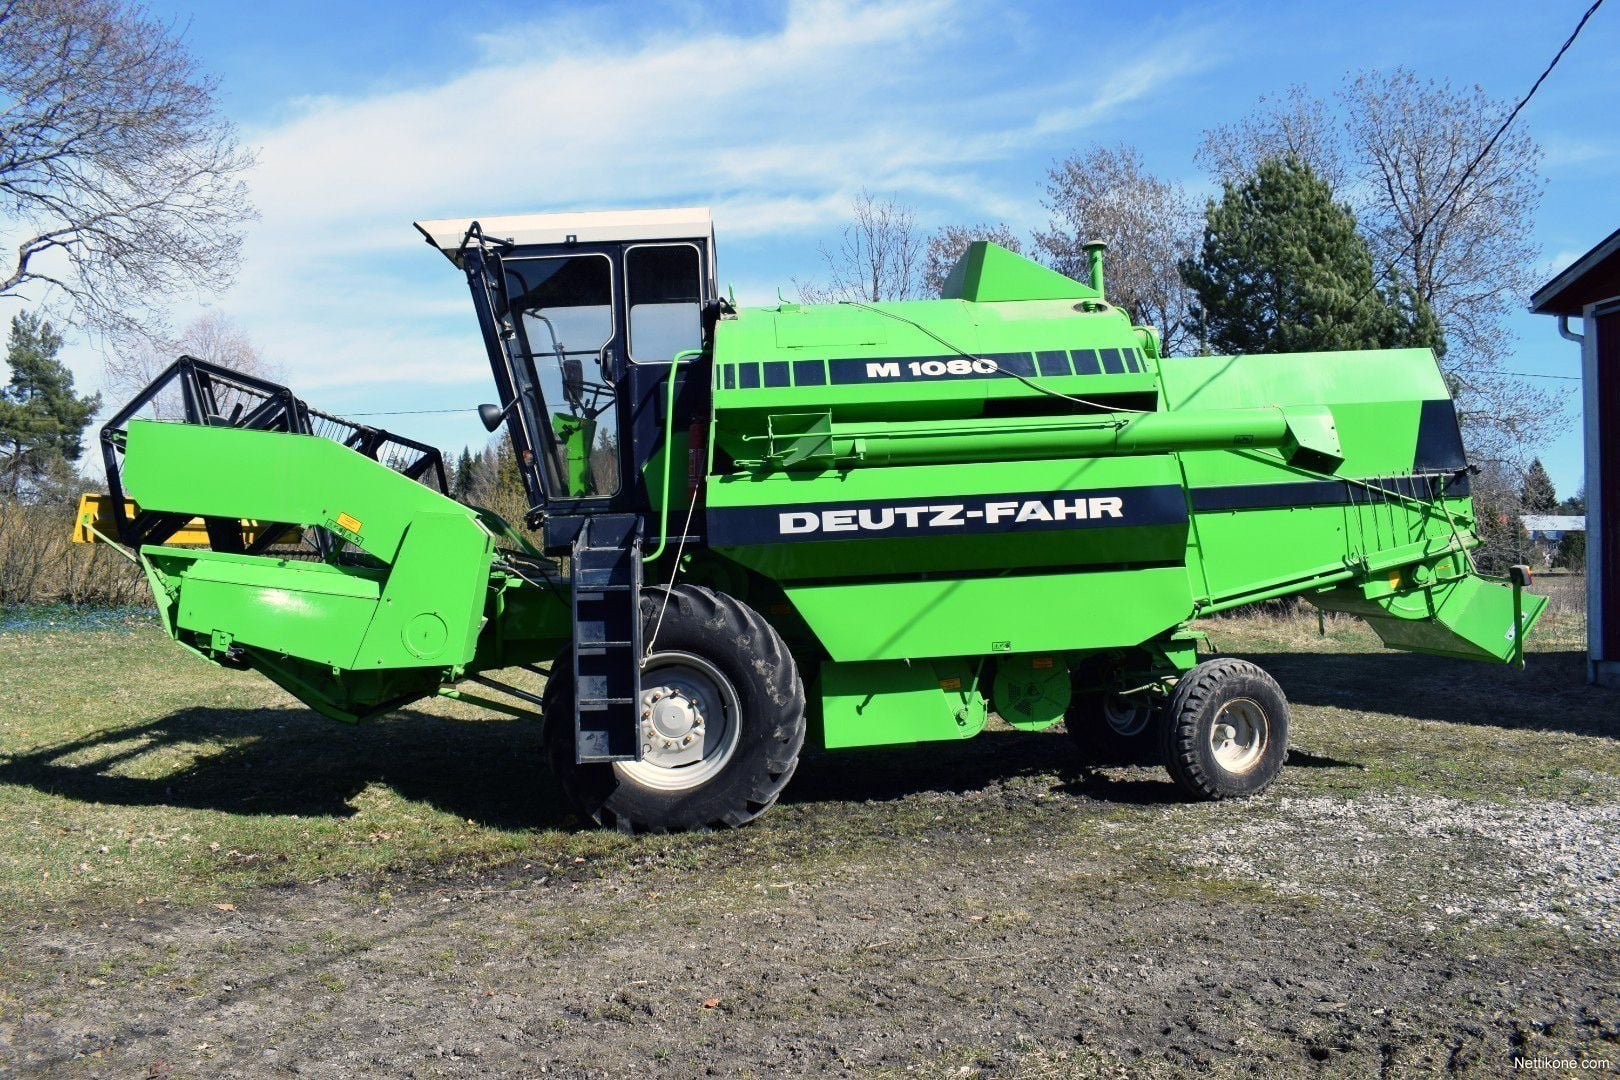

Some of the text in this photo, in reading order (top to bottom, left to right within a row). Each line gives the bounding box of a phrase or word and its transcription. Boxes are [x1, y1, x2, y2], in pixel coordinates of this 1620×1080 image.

[866, 359, 998, 378] M 1080
[779, 496, 1124, 534] DEUTZ-FAHR
